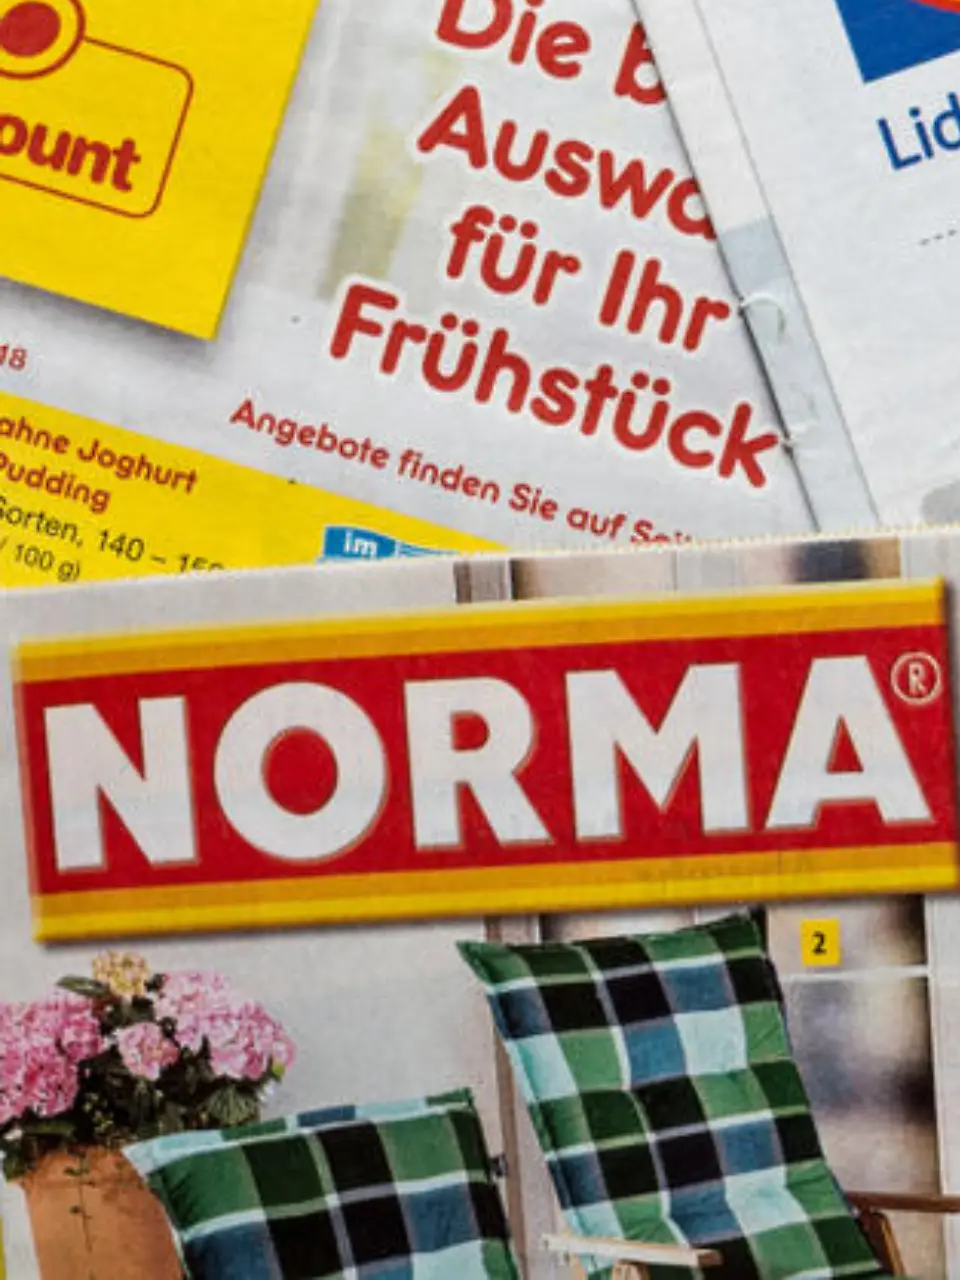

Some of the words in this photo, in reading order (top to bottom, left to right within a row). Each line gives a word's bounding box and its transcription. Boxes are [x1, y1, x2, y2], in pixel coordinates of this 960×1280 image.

[446, 206, 580, 305] für
[599, 251, 731, 351] Ihr
[329, 284, 780, 488] Frühstück
[77, 438, 197, 494] Joghurt
[229, 398, 390, 469] Angebote
[398, 449, 501, 504] finden
[507, 483, 559, 521] Sie
[565, 508, 627, 541] auf
[14, 543, 55, 572] 100
[100, 528, 144, 562] 140
[344, 530, 378, 556] im
[811, 933, 827, 956] 2
